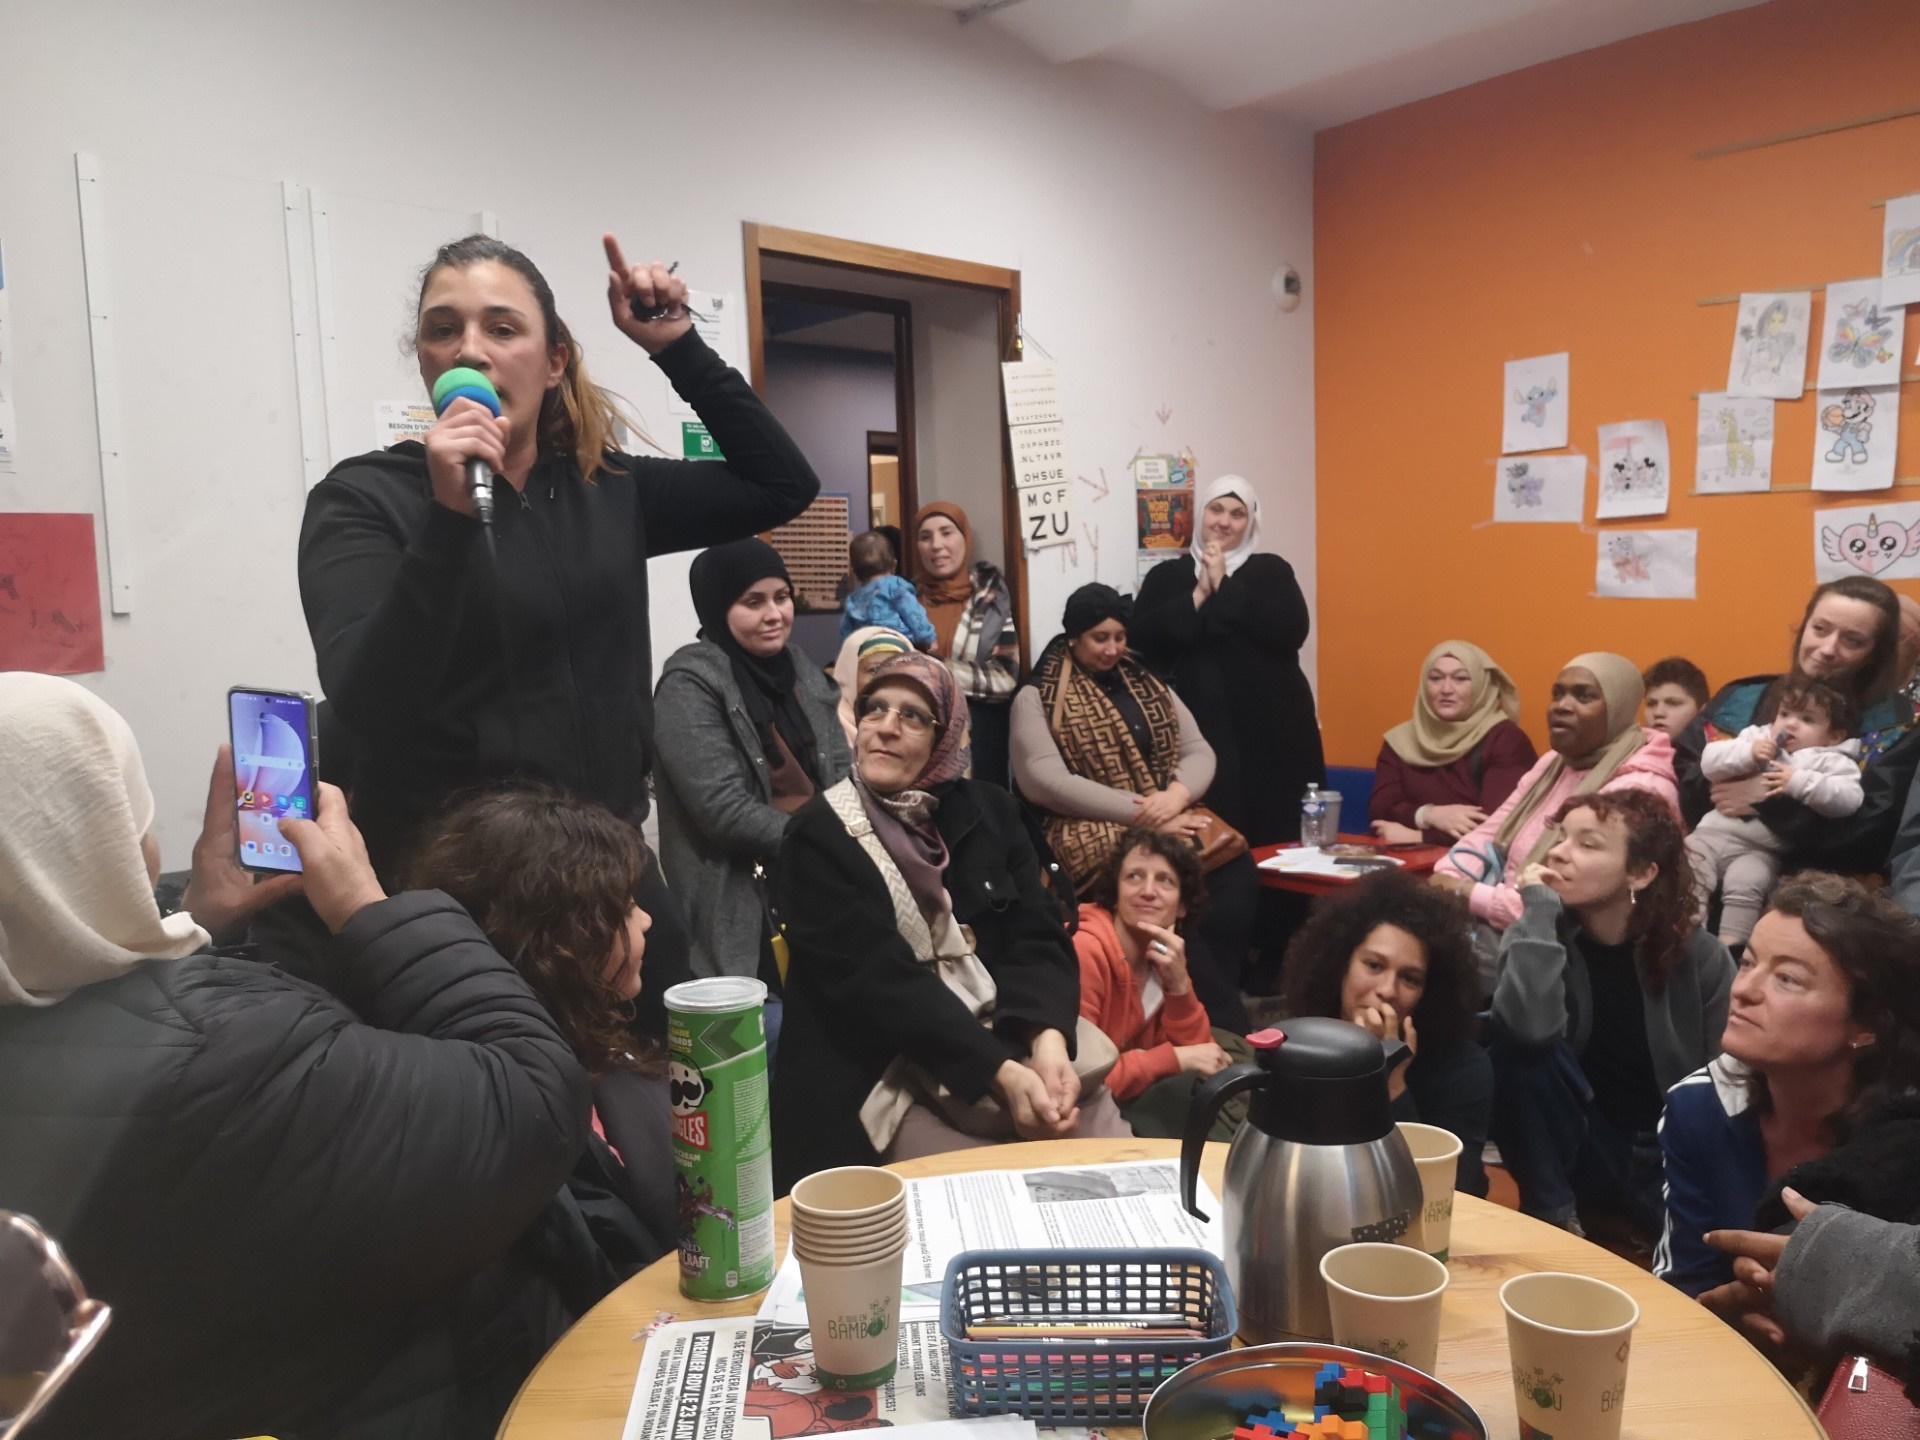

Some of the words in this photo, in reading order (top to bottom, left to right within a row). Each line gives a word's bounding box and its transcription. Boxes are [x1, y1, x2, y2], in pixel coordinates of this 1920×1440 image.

[388, 422, 413, 430] BESOIN
[1029, 511, 1069, 541] ZU
[690, 1335, 710, 1372] PREMIER
[685, 1373, 703, 1392] RDV
[682, 1393, 699, 1404] LE
[680, 1404, 697, 1418] 23
[721, 1405, 735, 1440] VENDRED
